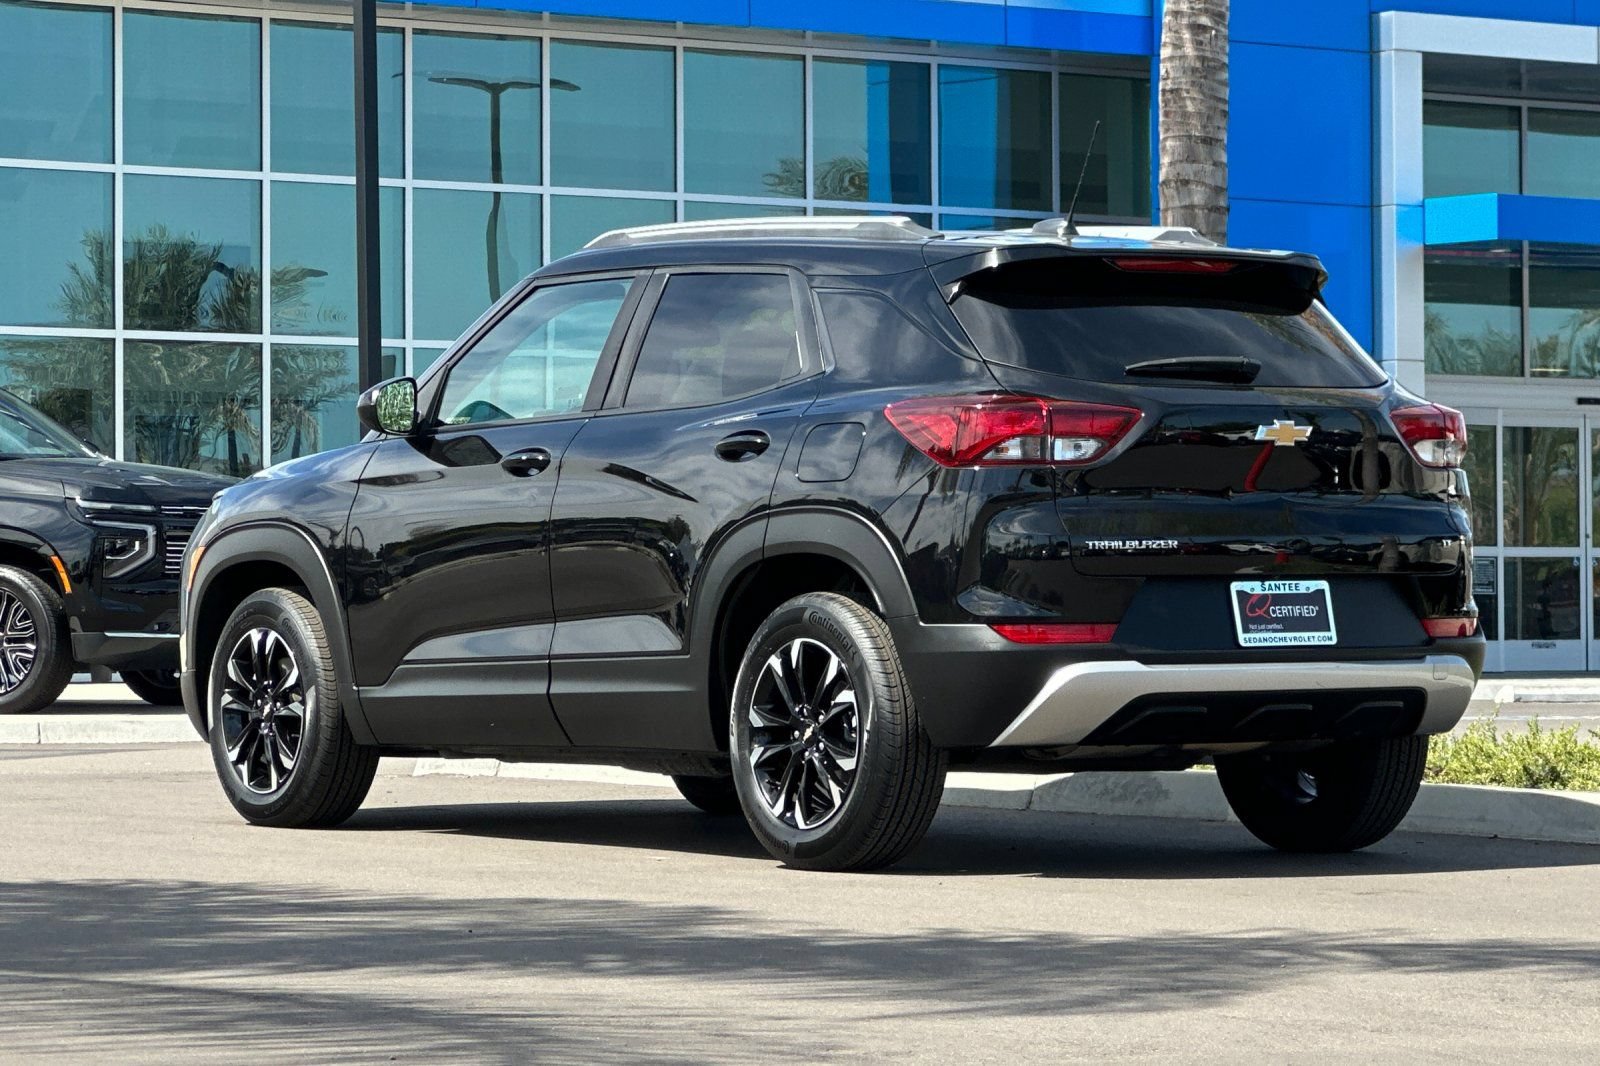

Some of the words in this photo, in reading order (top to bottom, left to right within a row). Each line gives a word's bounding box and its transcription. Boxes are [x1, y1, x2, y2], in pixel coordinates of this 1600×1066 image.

[1085, 540, 1178, 550] TRAILBLAZER
[1260, 582, 1300, 592] SANTEE
[809, 610, 853, 652] Continental
[1243, 635, 1333, 645] SEDANOCHEVROLET.COM
